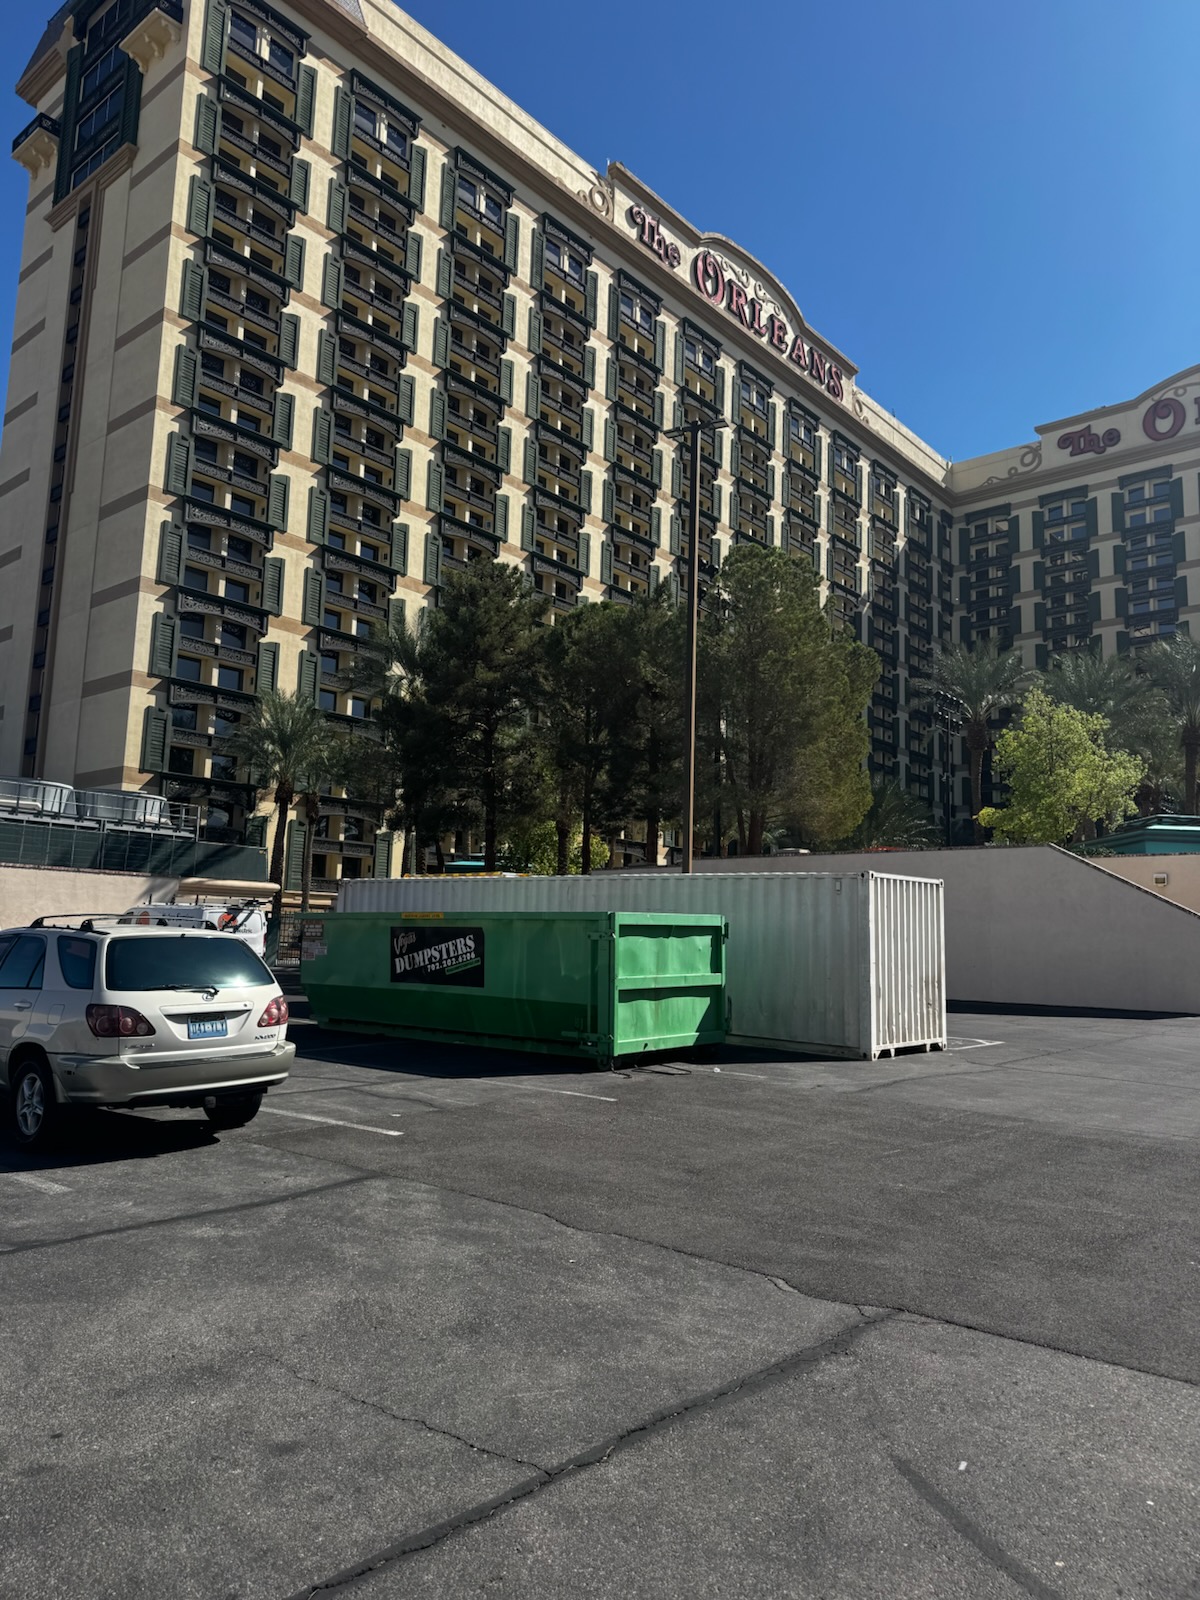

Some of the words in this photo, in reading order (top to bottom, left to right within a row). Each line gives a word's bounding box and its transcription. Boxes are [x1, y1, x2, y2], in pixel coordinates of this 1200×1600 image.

[629, 203, 681, 268] The
[696, 248, 844, 402] ORLEANS
[1057, 424, 1121, 457] The
[393, 931, 417, 955] Vegas
[394, 934, 476, 974] DUMPSTERS
